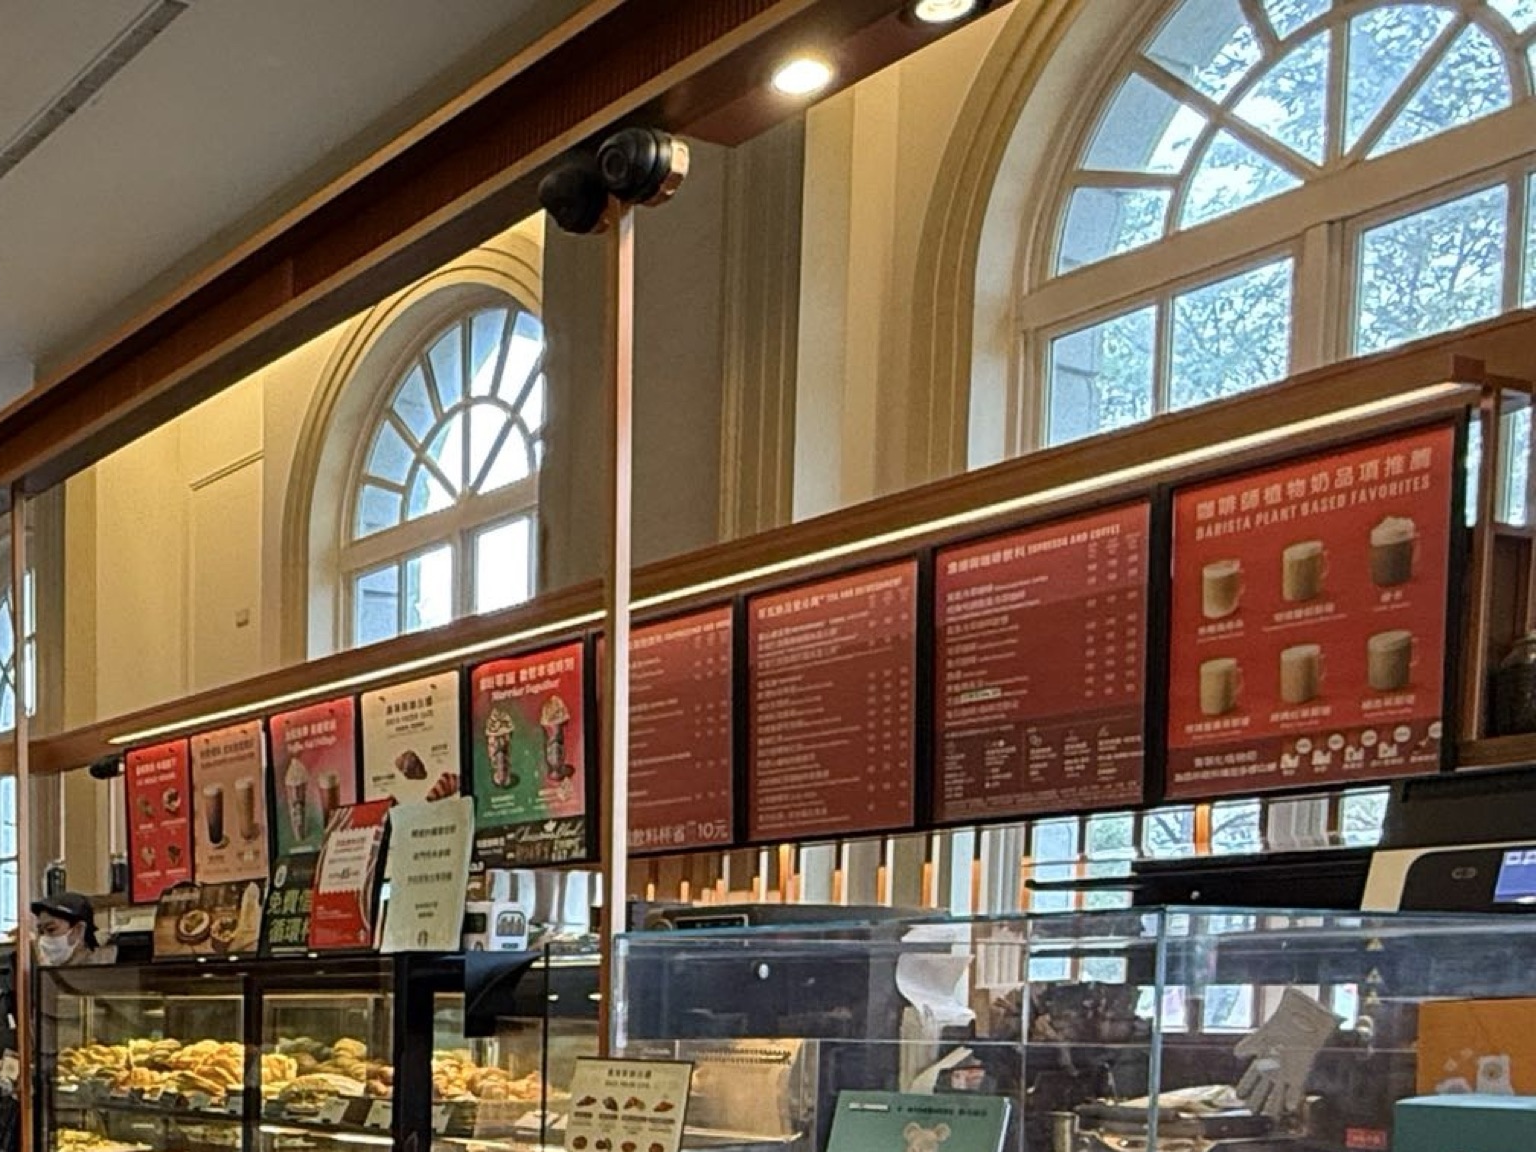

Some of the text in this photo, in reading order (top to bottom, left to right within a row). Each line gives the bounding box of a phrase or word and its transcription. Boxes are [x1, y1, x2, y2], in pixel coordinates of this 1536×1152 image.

[1196, 474, 1431, 541] BARISTA PLANT BASED FAVORITES
